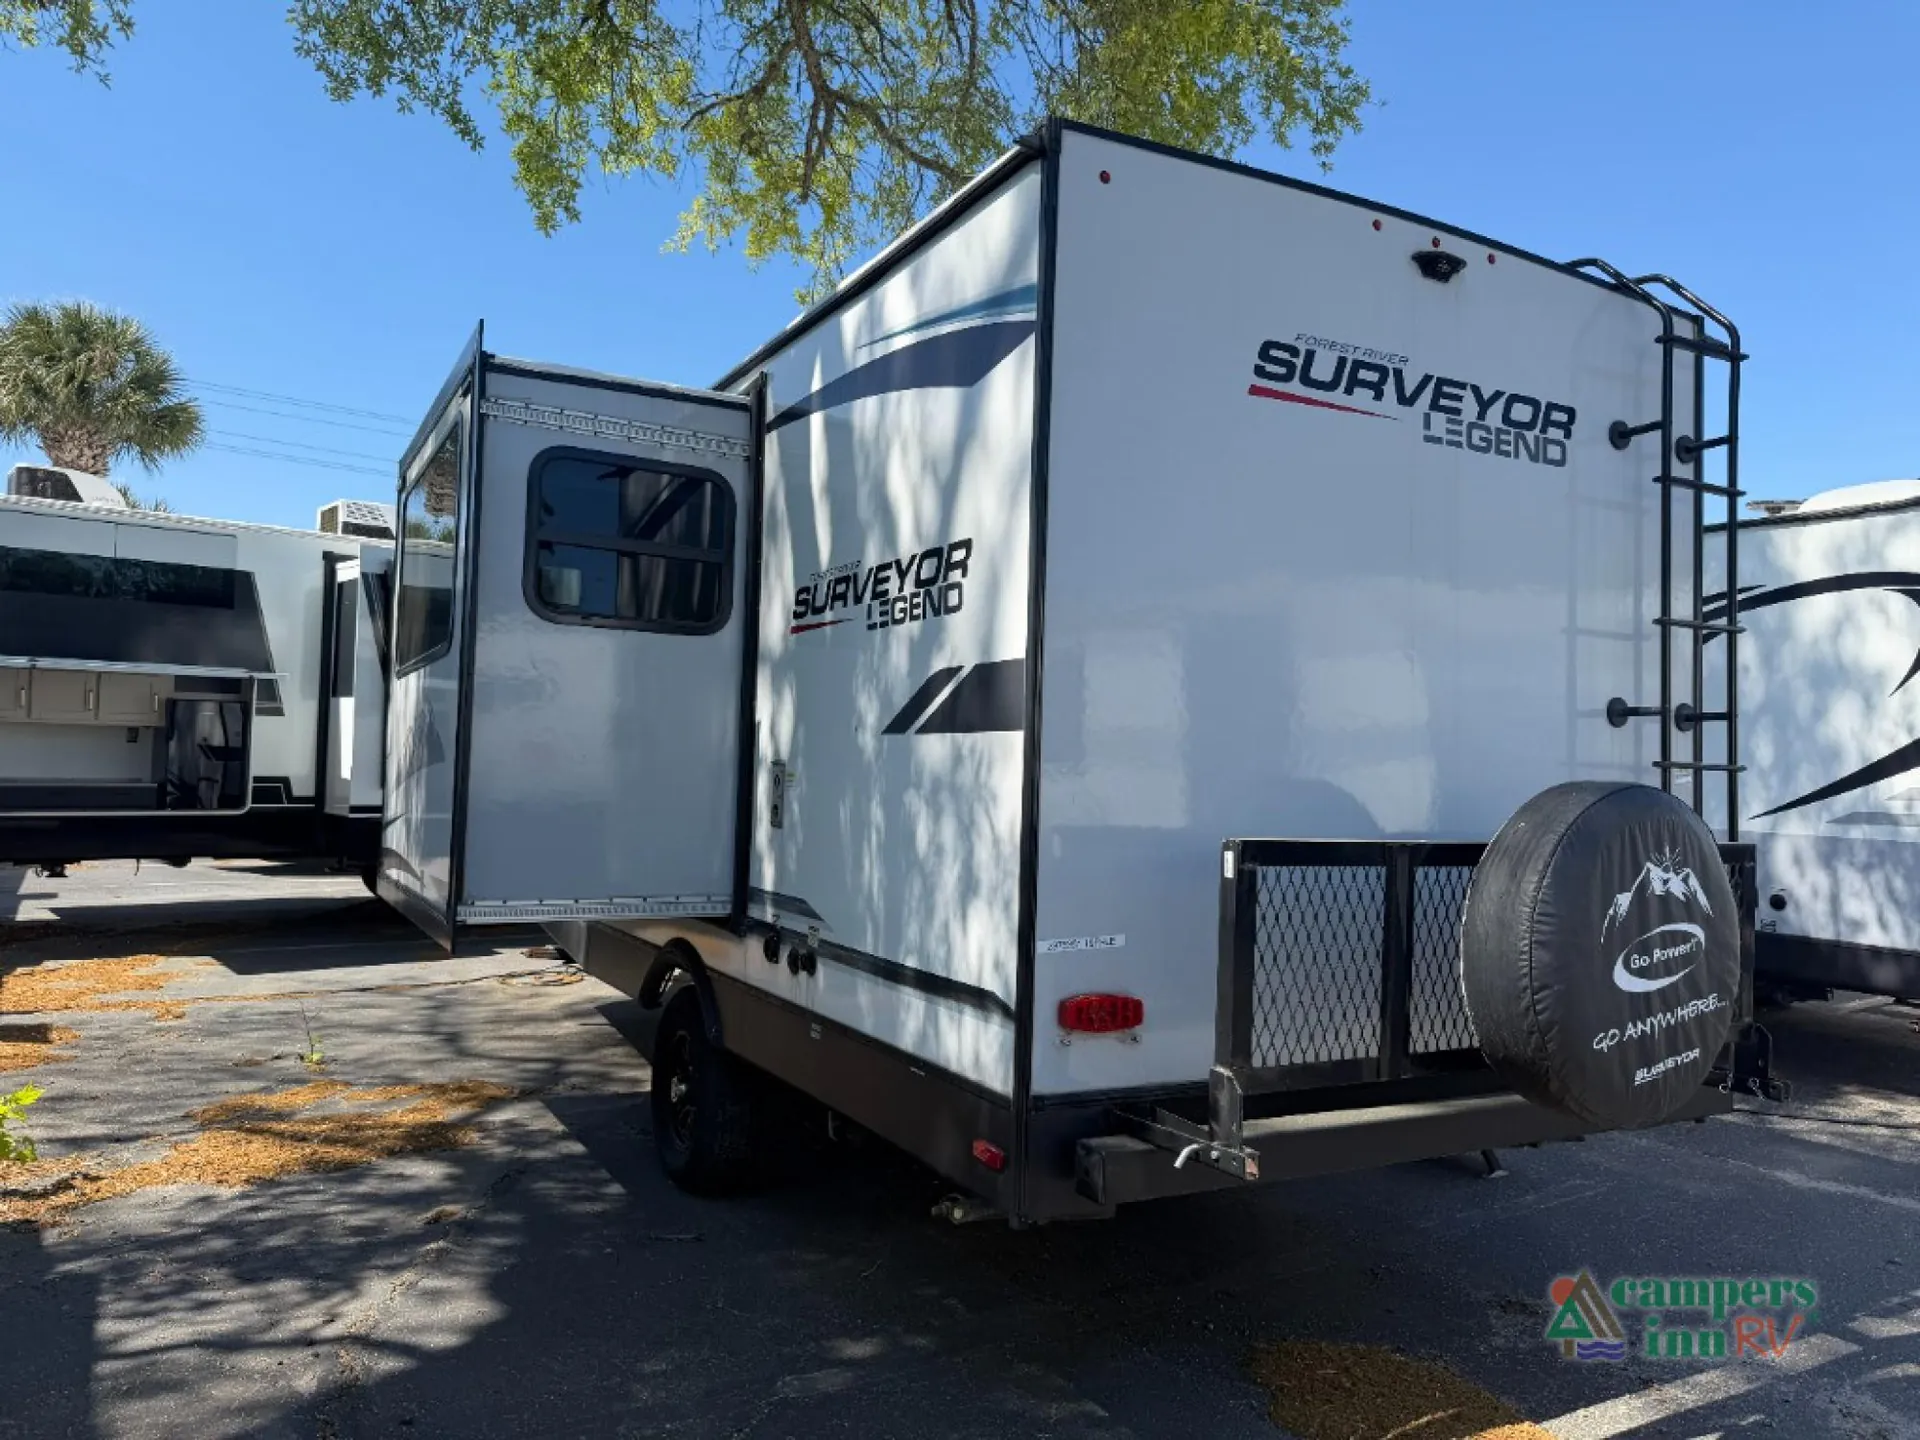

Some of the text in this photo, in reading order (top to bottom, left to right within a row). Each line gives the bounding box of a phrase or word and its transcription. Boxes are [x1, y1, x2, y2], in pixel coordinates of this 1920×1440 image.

[1295, 333, 1409, 366] FOREST RIVER
[1253, 339, 1577, 440] SURVEYOR
[1422, 411, 1567, 468] LEGEND
[793, 537, 973, 620] SURVEYOR
[866, 580, 964, 631] LEGEND
[1630, 953, 1650, 969] Go
[1593, 1028, 1620, 1053] GO
